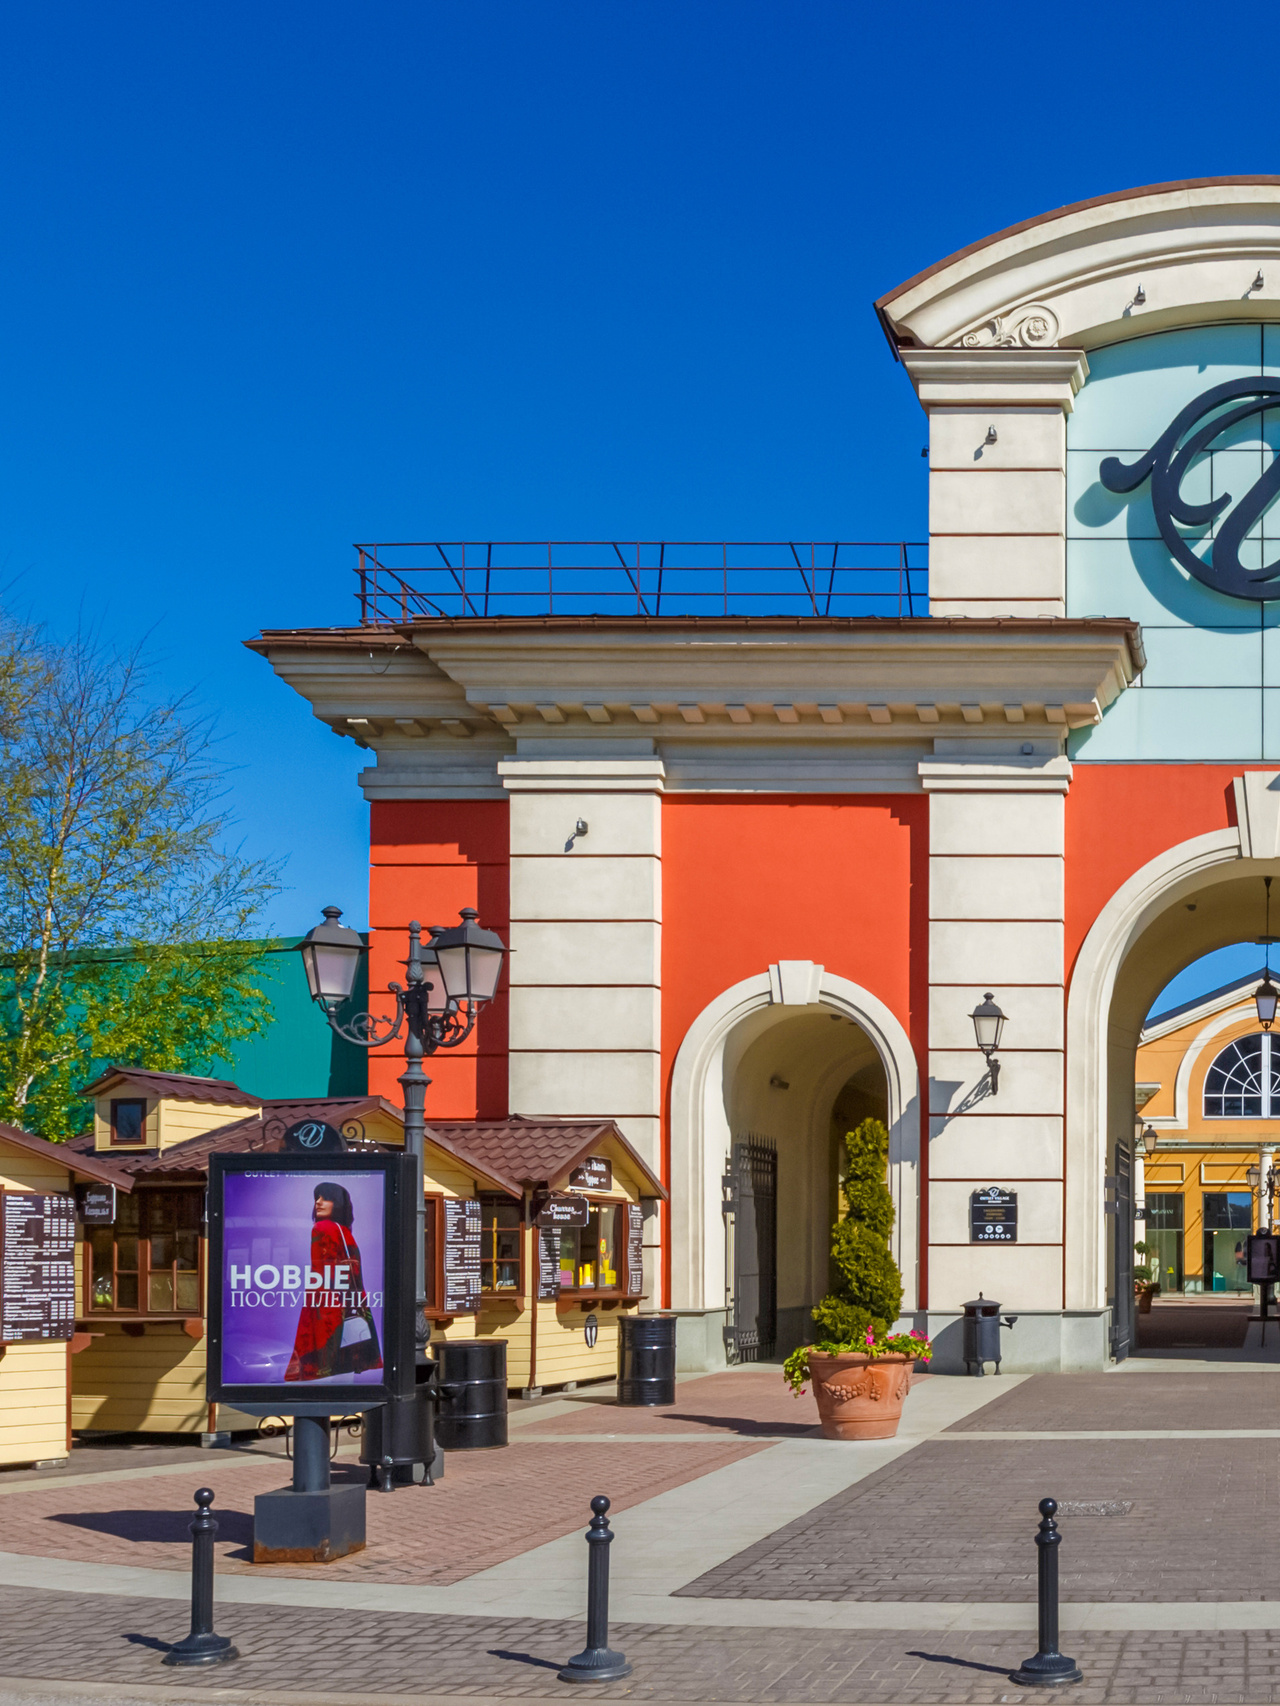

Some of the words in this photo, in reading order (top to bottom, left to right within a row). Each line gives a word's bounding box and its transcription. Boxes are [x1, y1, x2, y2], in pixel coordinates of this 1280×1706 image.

[549, 1204, 575, 1213] Churros
[230, 1264, 350, 1290] НОВЫЕ
[231, 1291, 383, 1308] ПОСТУПЛЕНИЯ
